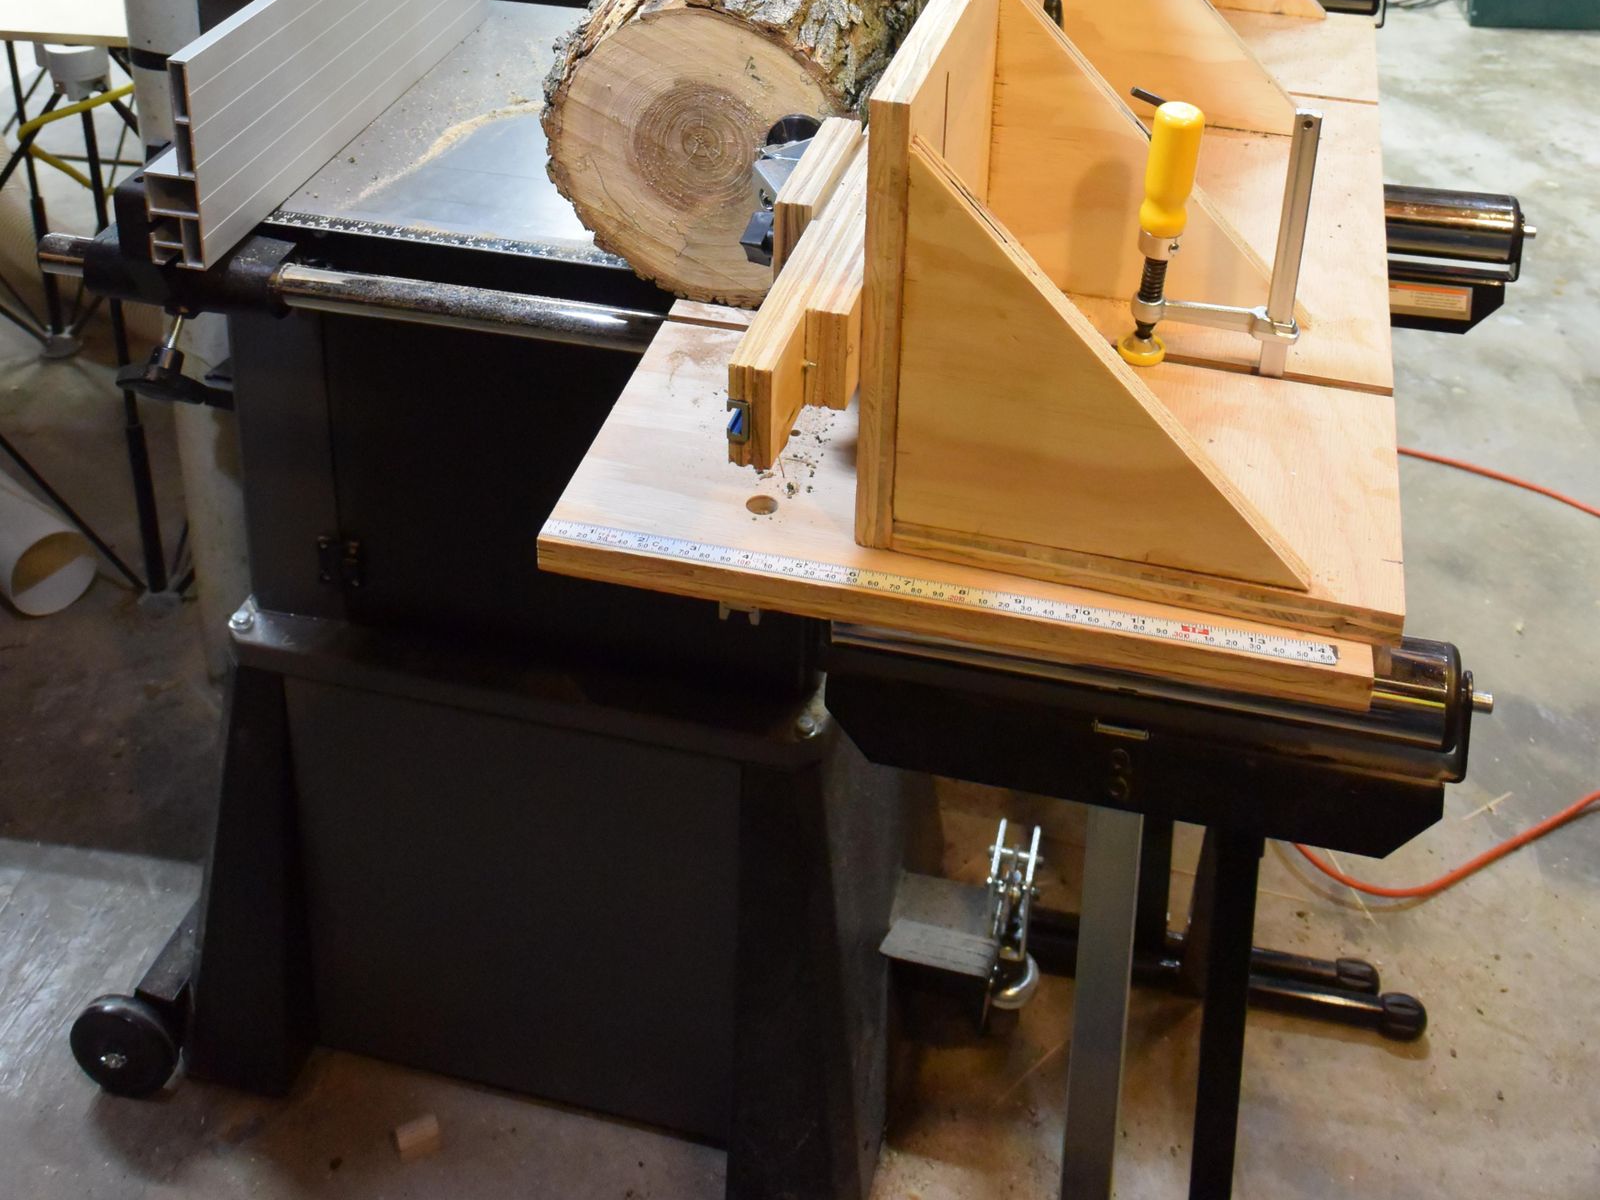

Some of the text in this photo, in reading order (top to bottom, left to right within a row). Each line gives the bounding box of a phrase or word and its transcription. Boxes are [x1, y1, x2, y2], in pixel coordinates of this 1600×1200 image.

[1075, 608, 1090, 616] 10
[1249, 637, 1266, 645] 13
[1308, 646, 1325, 654] 14
